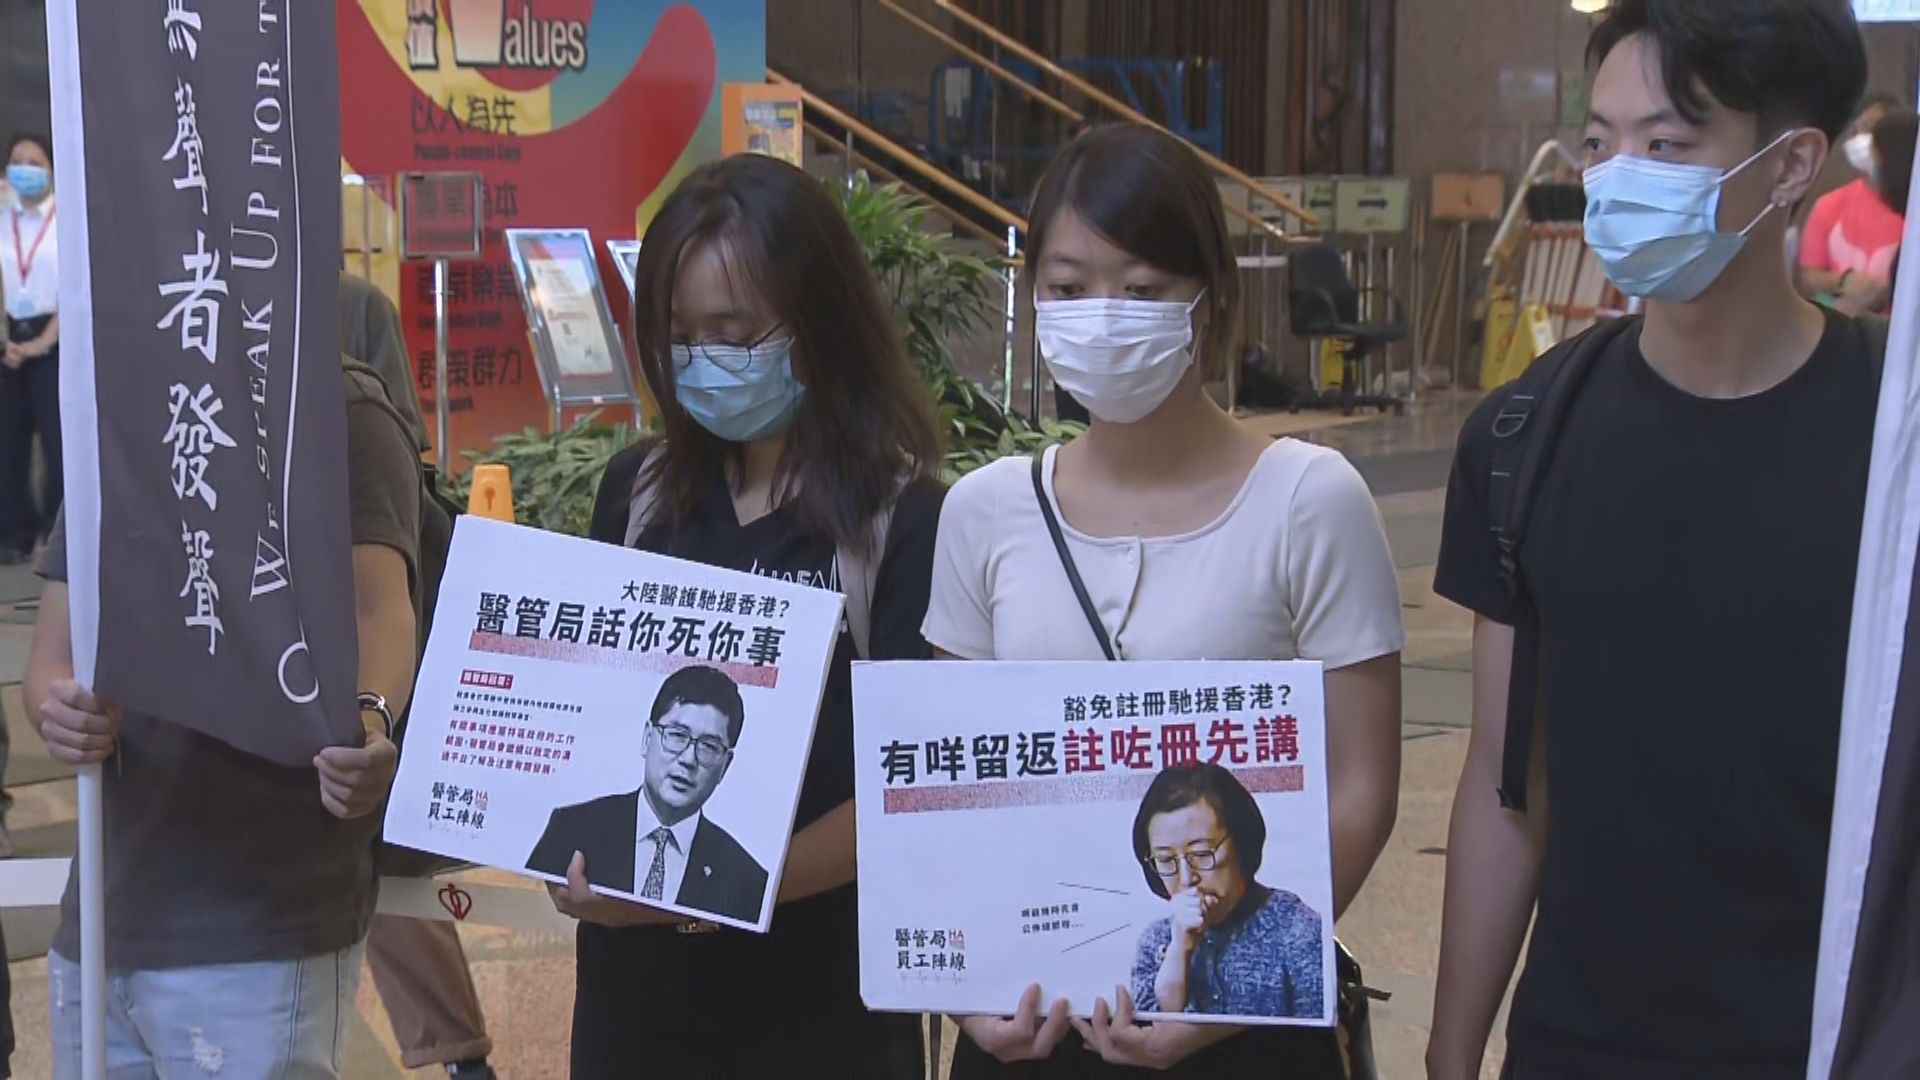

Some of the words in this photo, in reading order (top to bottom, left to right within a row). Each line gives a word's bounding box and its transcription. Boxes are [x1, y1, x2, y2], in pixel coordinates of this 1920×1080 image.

[250, 57, 282, 168] FOR
[230, 191, 281, 270] UP
[620, 580, 791, 619] 大陸醫護馳援香港?
[475, 590, 787, 668] 醫管局話你死你事
[1063, 683, 1293, 722] 豁免註冊馳援香港?
[880, 714, 1300, 786] 有咩留返註咗冊先講
[431, 781, 474, 807] 醫管局
[894, 927, 947, 949] 醫管局
[896, 950, 967, 971] 員工陣線
